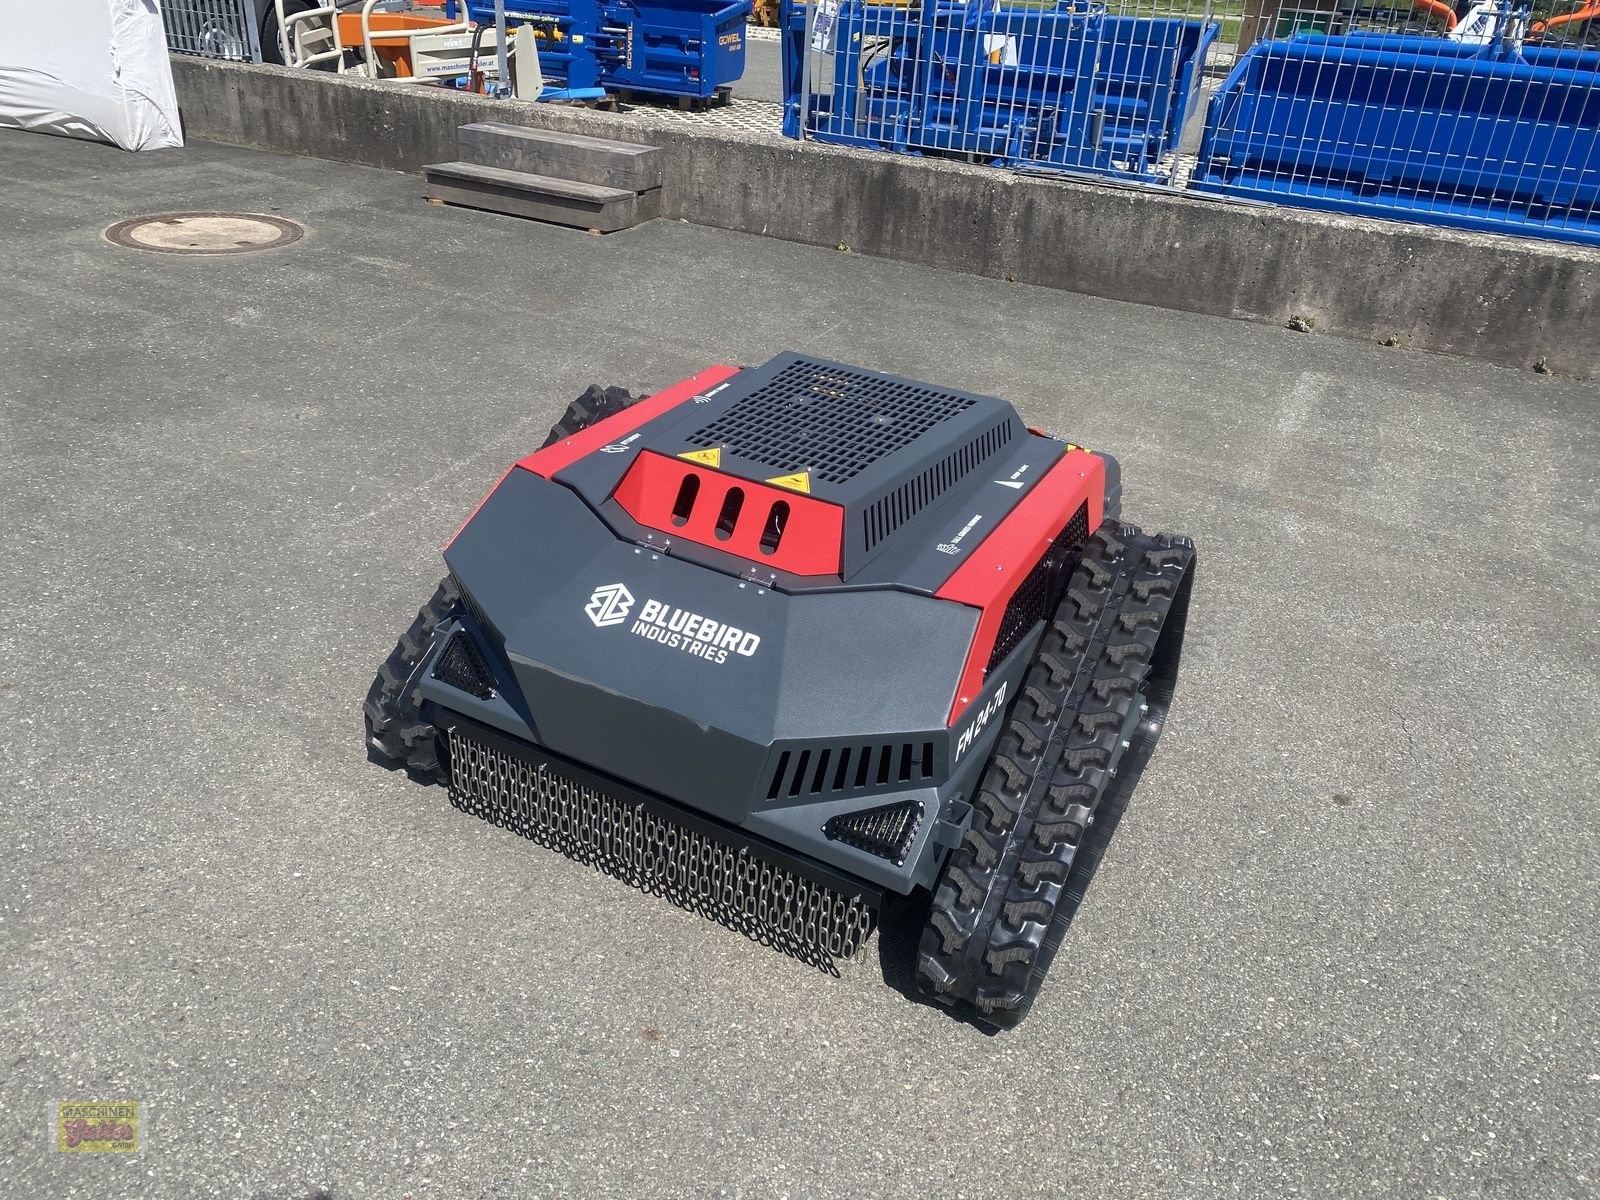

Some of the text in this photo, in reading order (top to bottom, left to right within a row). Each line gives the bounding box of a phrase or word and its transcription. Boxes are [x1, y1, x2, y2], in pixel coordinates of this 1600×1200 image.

[630, 620, 729, 665] INDUSTRIES
[638, 598, 761, 657] BLUEBIRD
[954, 680, 1008, 763] FM 24-70
